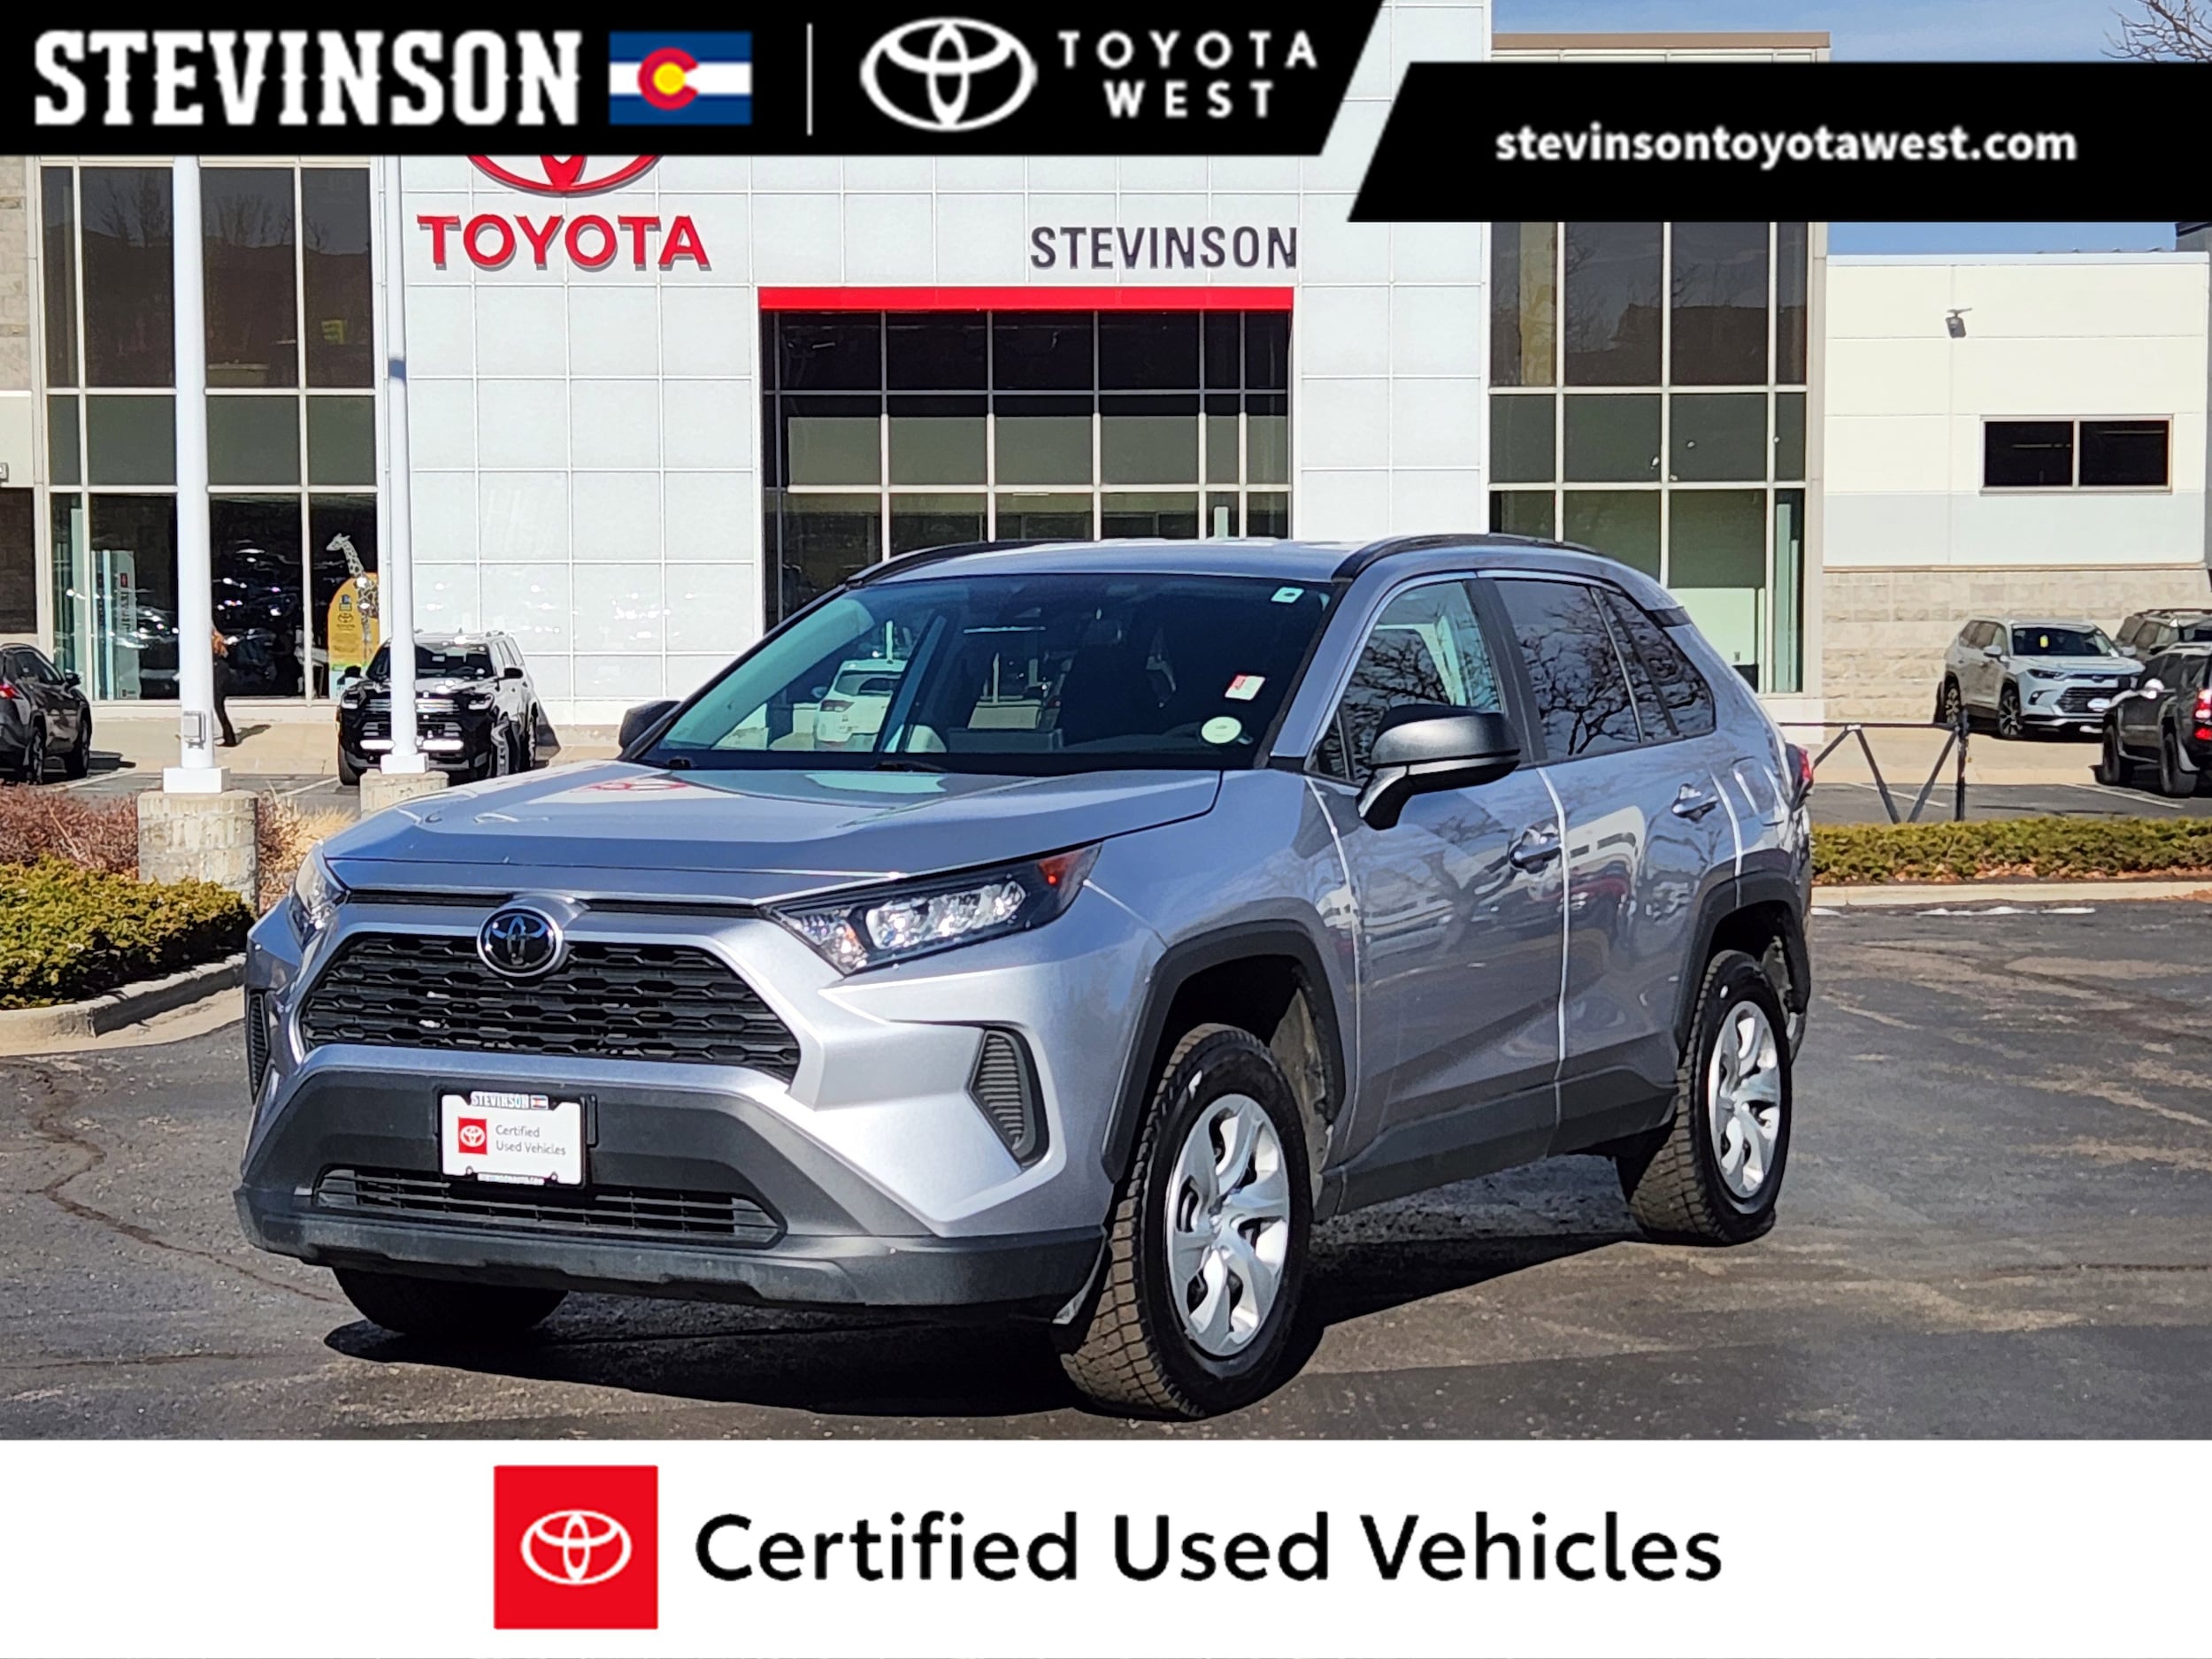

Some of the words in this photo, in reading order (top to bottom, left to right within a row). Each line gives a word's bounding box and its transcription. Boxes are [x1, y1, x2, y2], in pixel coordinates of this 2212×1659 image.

[418, 214, 710, 270] TOYOTA
[1030, 226, 1298, 269] STEVINSON
[472, 1093, 529, 1109] STEVINSON
[495, 1125, 540, 1138] Certified
[495, 1141, 522, 1152] Used
[525, 1142, 567, 1156] Vehicles
